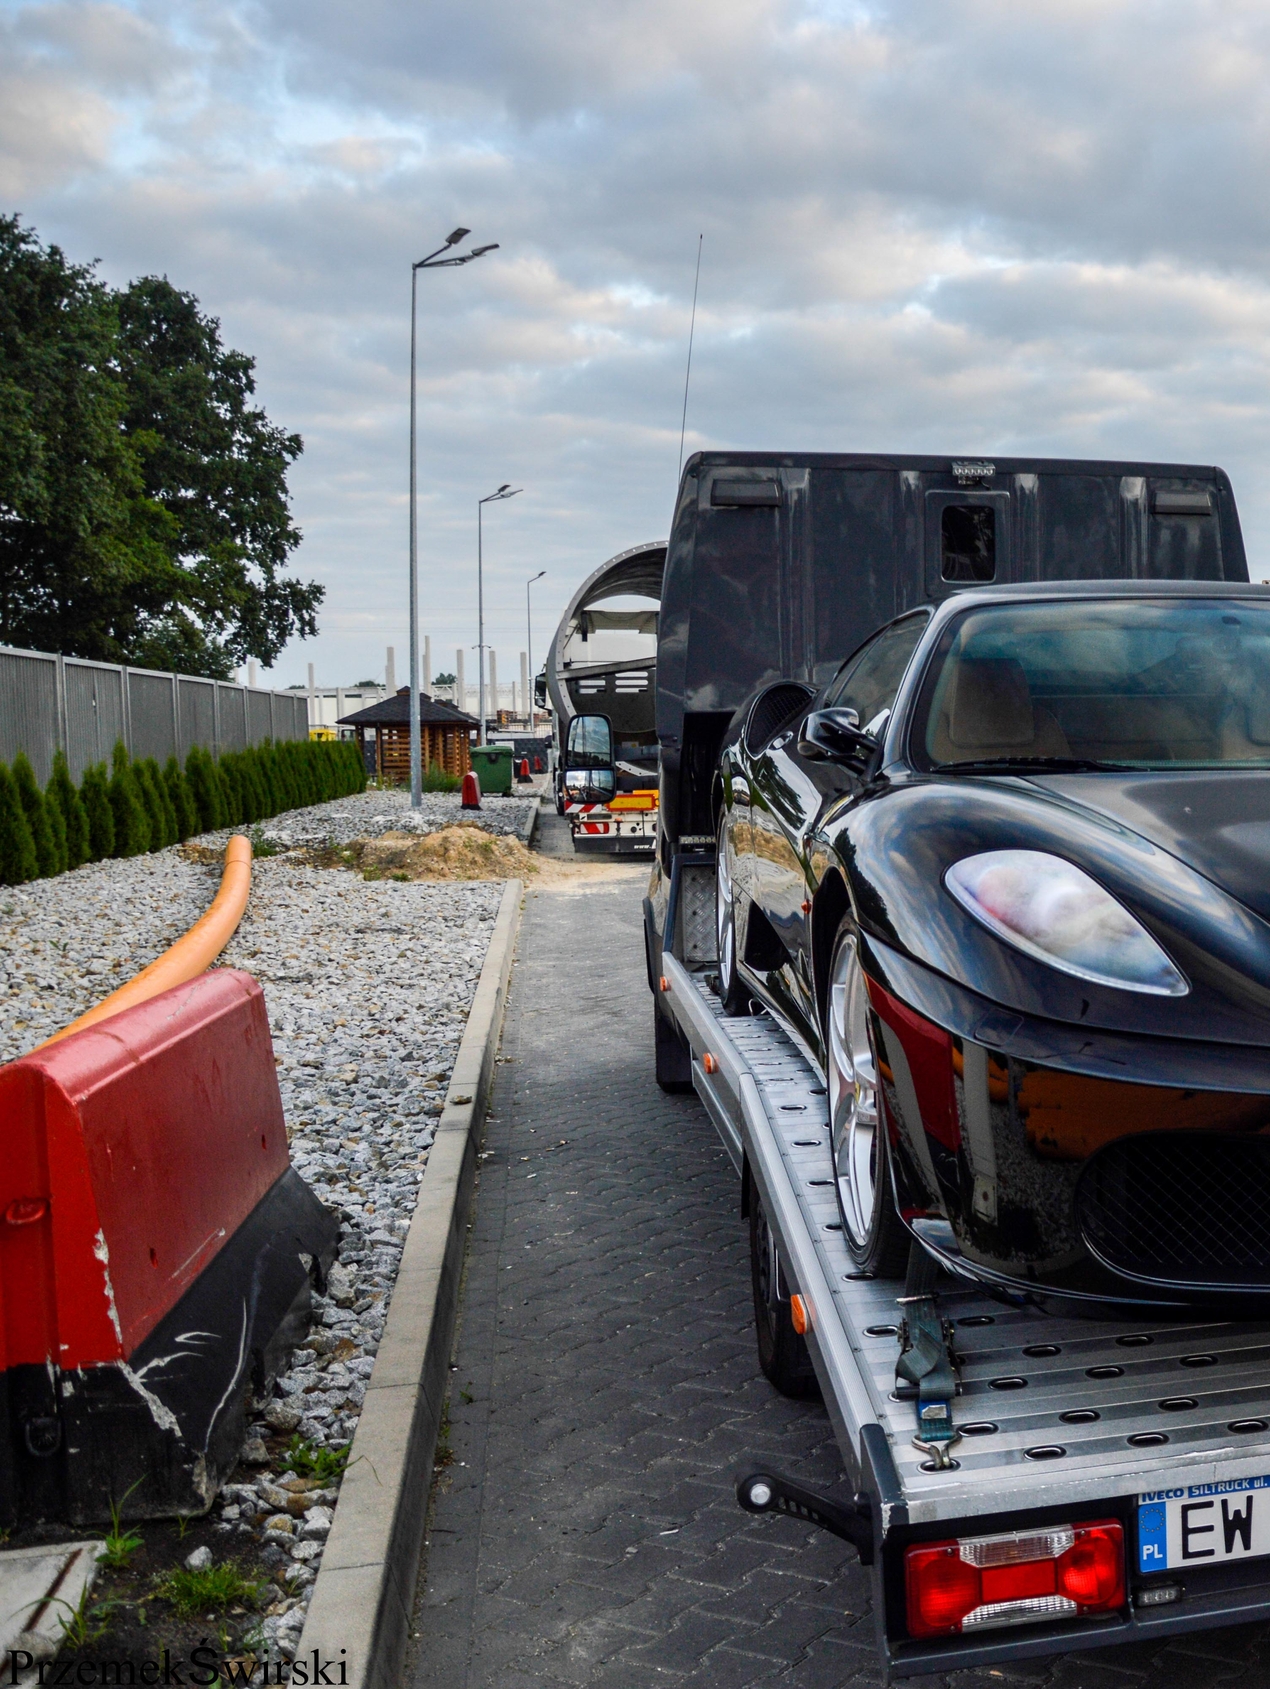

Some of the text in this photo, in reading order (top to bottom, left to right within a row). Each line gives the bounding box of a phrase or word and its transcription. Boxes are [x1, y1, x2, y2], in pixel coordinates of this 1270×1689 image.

[1142, 1488, 1185, 1503] IVECO
[1191, 1479, 1250, 1496] SILTRUCK
[1254, 1476, 1268, 1488] ul.
[1142, 1545, 1164, 1560] PL
